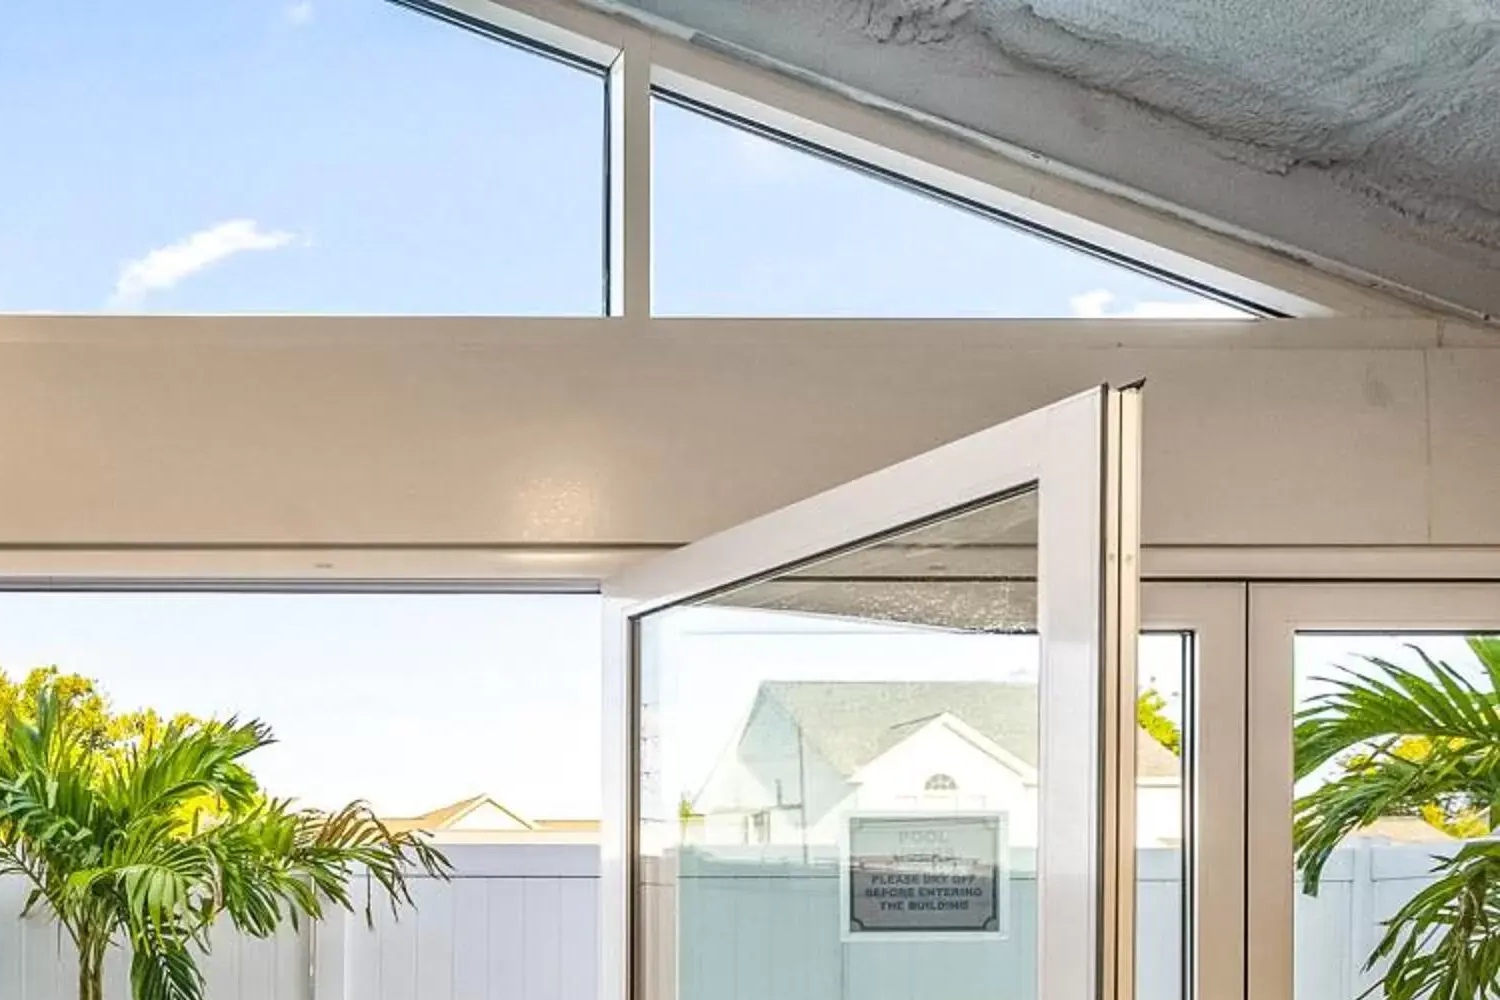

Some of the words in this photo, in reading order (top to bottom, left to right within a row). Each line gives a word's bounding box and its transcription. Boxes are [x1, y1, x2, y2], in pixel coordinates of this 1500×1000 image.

[871, 874, 920, 885] PLEASE
[924, 874, 949, 885] DRY
[952, 875, 977, 885] OFF
[865, 887, 915, 898] BEFORE
[918, 887, 983, 898] ENTERING
[880, 901, 904, 911] THE
[908, 901, 970, 911] BUILDING
